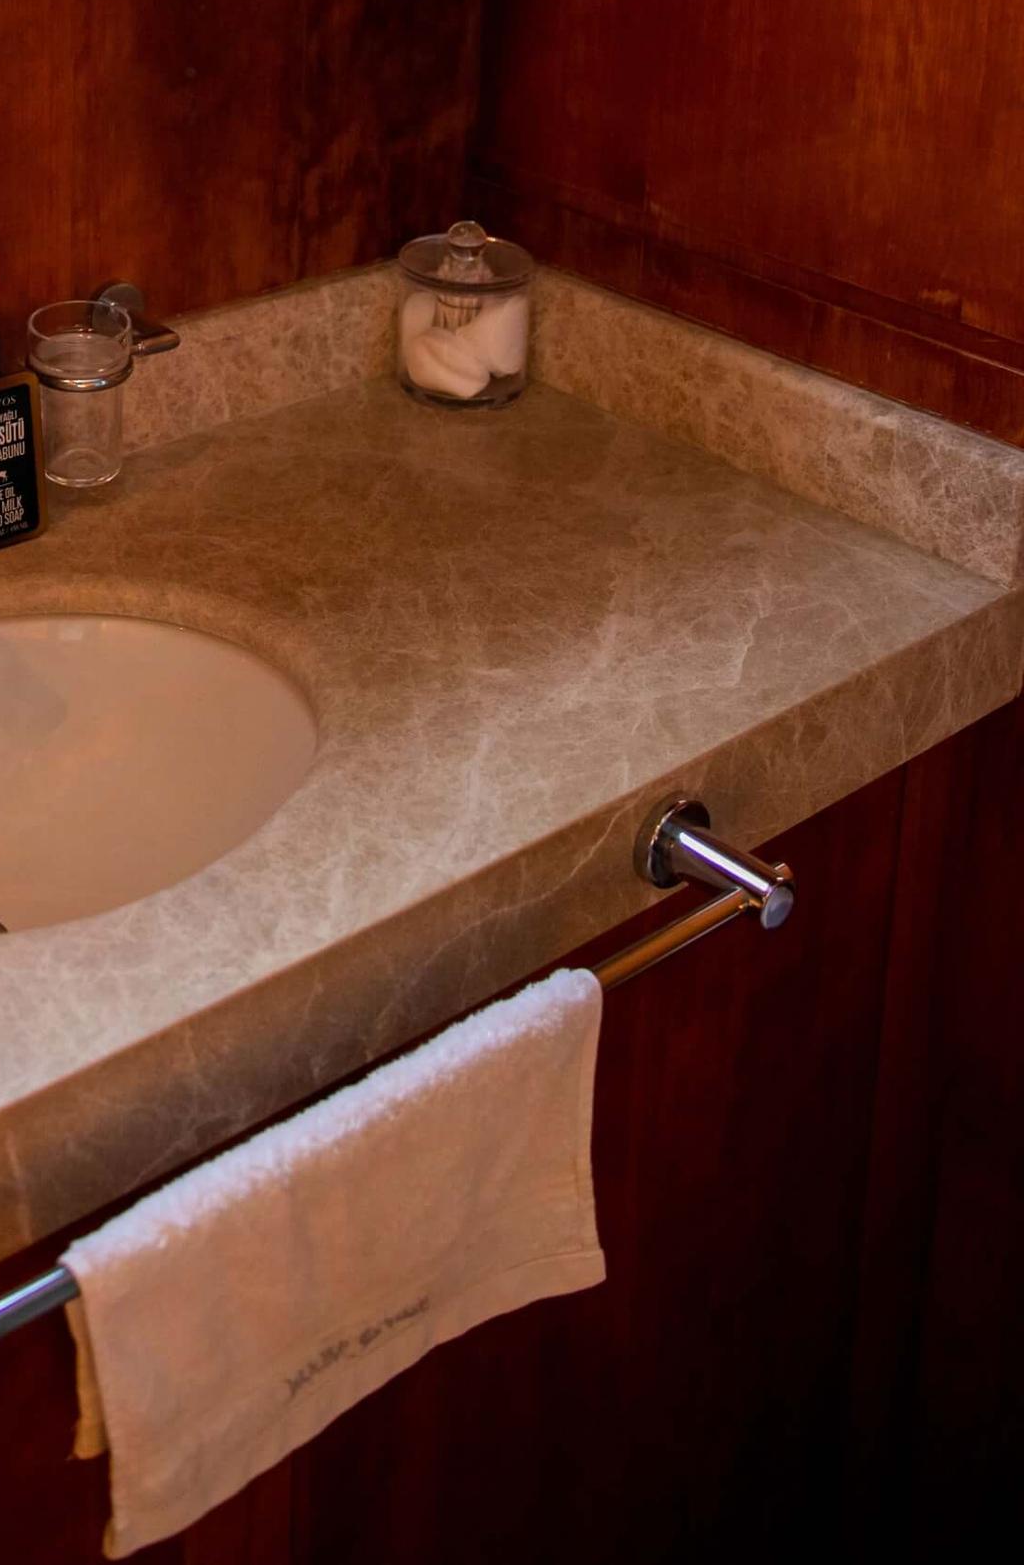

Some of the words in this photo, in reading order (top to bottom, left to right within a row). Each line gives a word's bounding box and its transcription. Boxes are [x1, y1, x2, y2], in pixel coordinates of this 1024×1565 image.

[0, 417, 25, 446] SÜTÜ
[5, 486, 16, 499] OIL
[2, 496, 22, 514] MILK
[4, 508, 25, 526] SOAP
